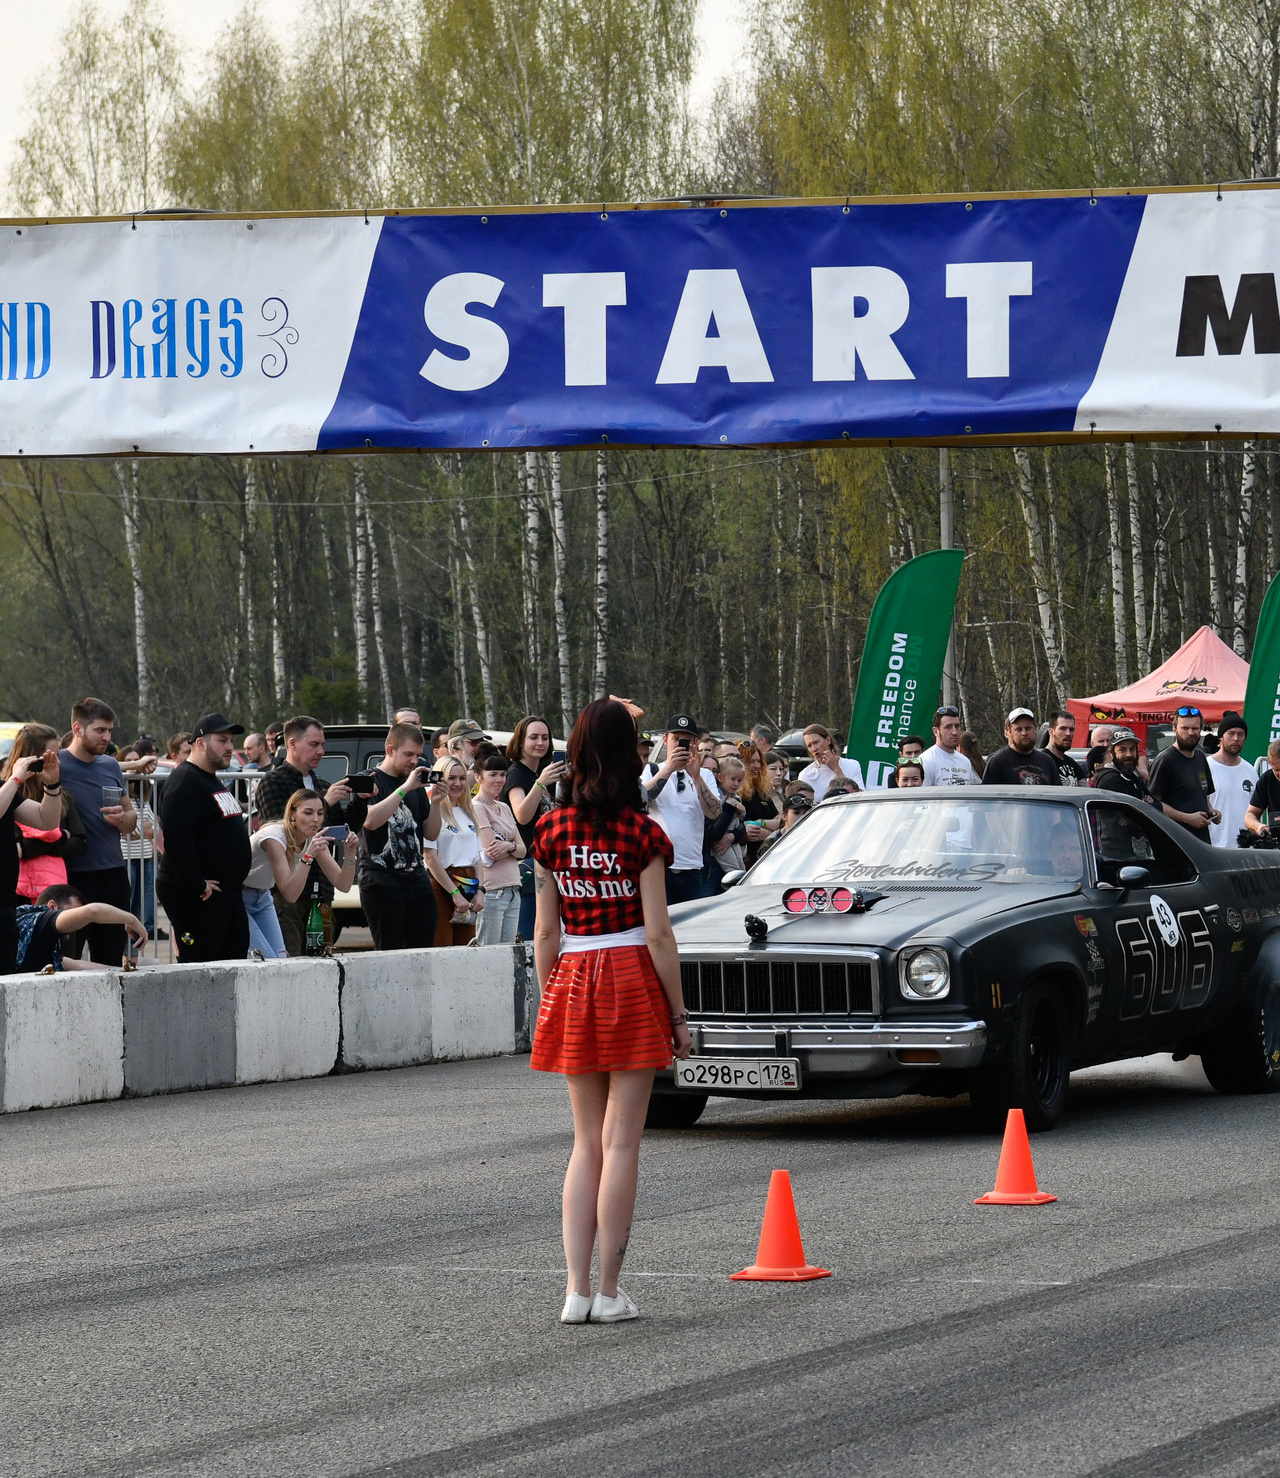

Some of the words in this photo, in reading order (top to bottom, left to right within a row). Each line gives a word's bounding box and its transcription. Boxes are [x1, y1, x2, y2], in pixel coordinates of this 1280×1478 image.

[90, 298, 243, 378] DRAGS
[419, 261, 1033, 392] START
[875, 632, 908, 748] FREEDOM
[553, 871, 597, 898] Kiss
[569, 845, 621, 875] Hey,
[1156, 903, 1172, 928] 43
[1115, 910, 1214, 1021] 606
[762, 1064, 791, 1080] 178
